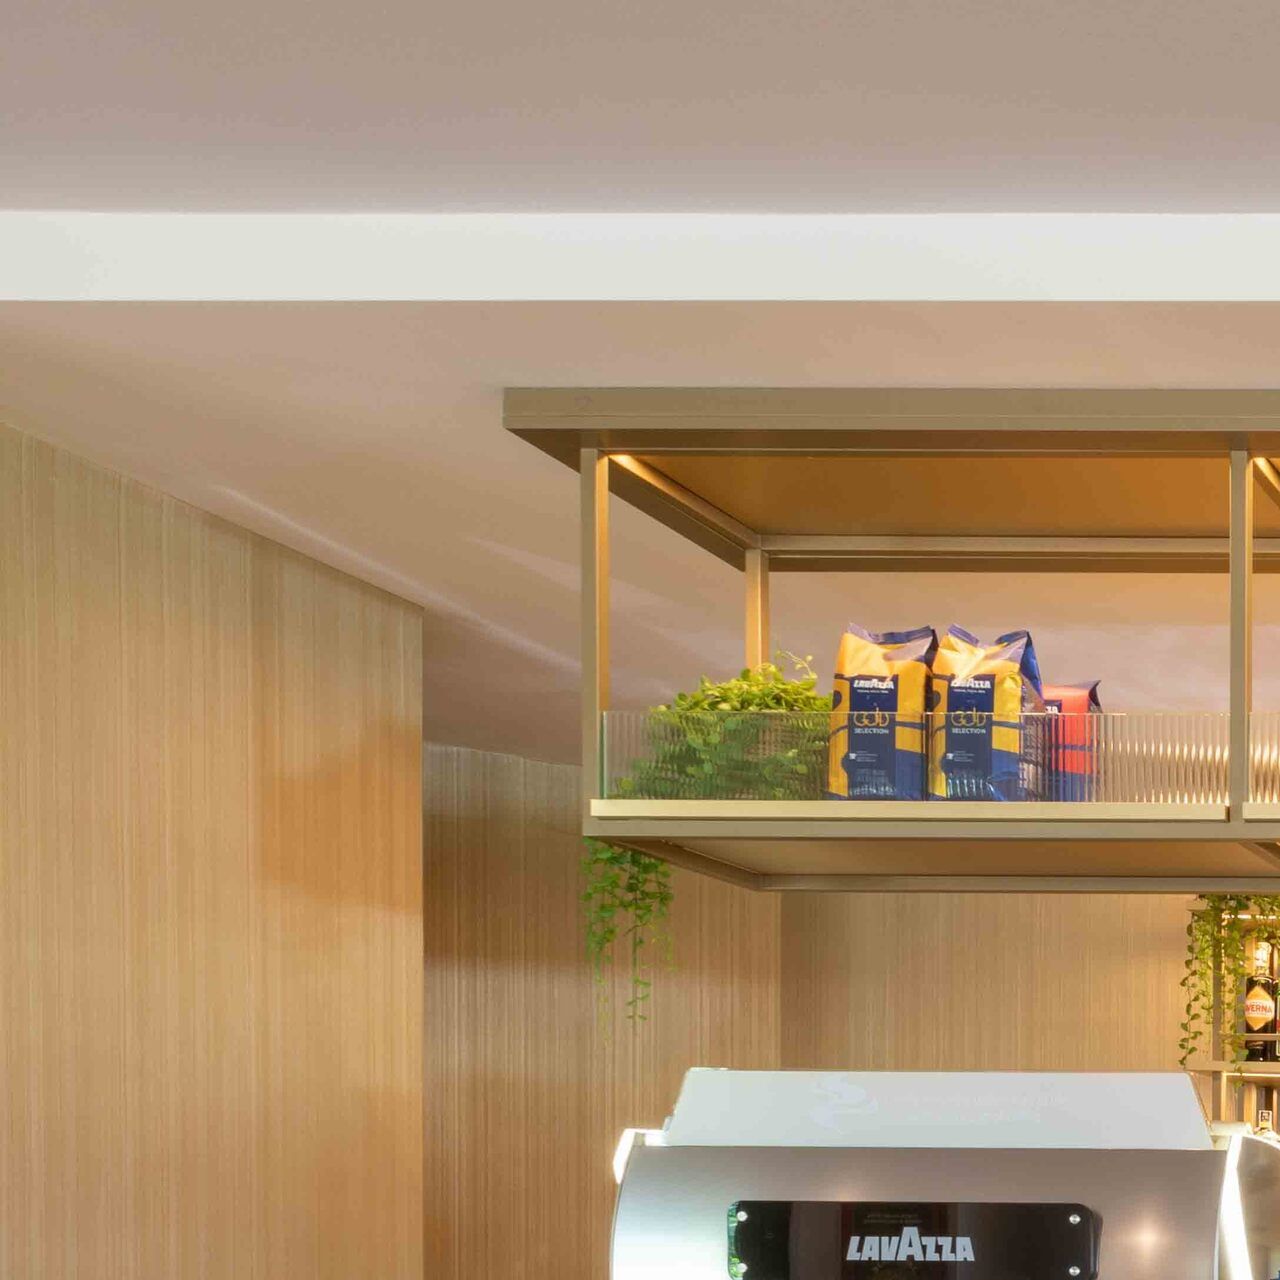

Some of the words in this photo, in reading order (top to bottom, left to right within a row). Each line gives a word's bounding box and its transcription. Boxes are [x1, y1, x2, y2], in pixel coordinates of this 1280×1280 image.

[853, 727, 890, 735] SELECTION
[951, 727, 987, 735] SELECTION
[846, 1226, 976, 1262] LAVAZZA
